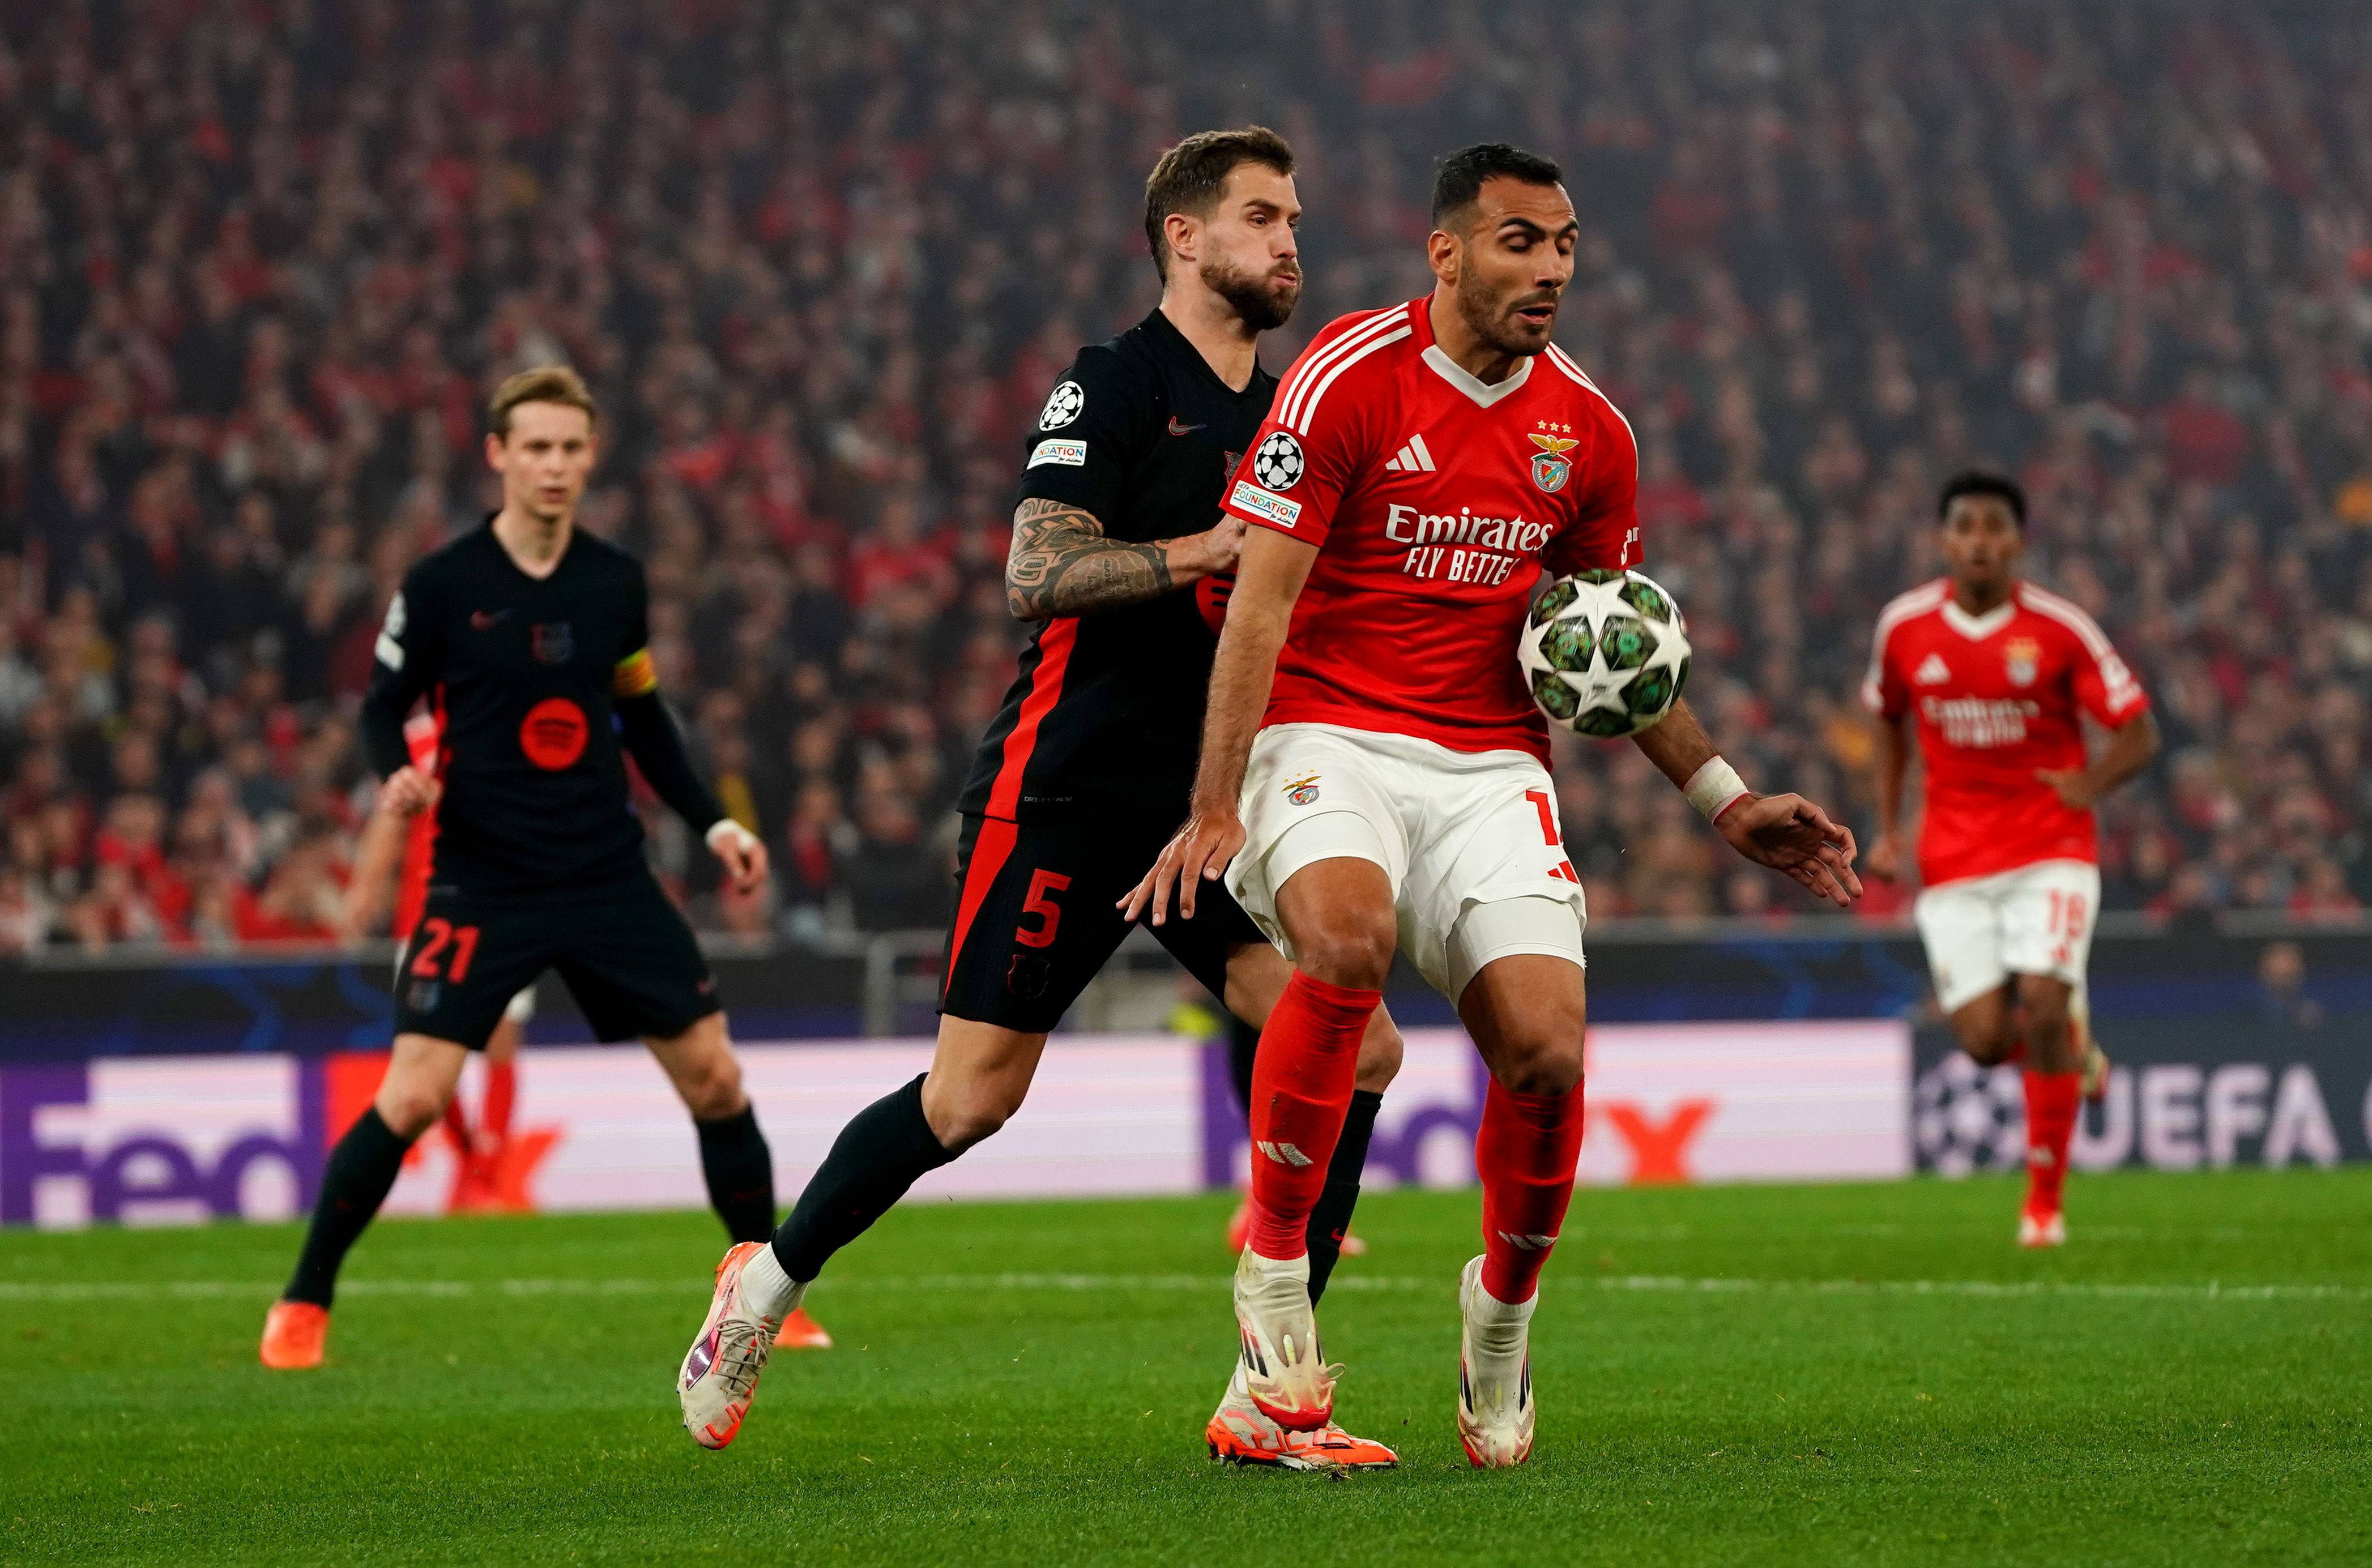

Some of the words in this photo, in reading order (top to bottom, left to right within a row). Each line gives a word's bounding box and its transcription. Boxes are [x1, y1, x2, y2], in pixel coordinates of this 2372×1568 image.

[1234, 489, 1297, 519] FOUNDATION
[1385, 503, 1554, 552] Emirates
[1402, 546, 1445, 578] FLY
[1015, 868, 1072, 948] 5
[410, 916, 482, 985] 21
